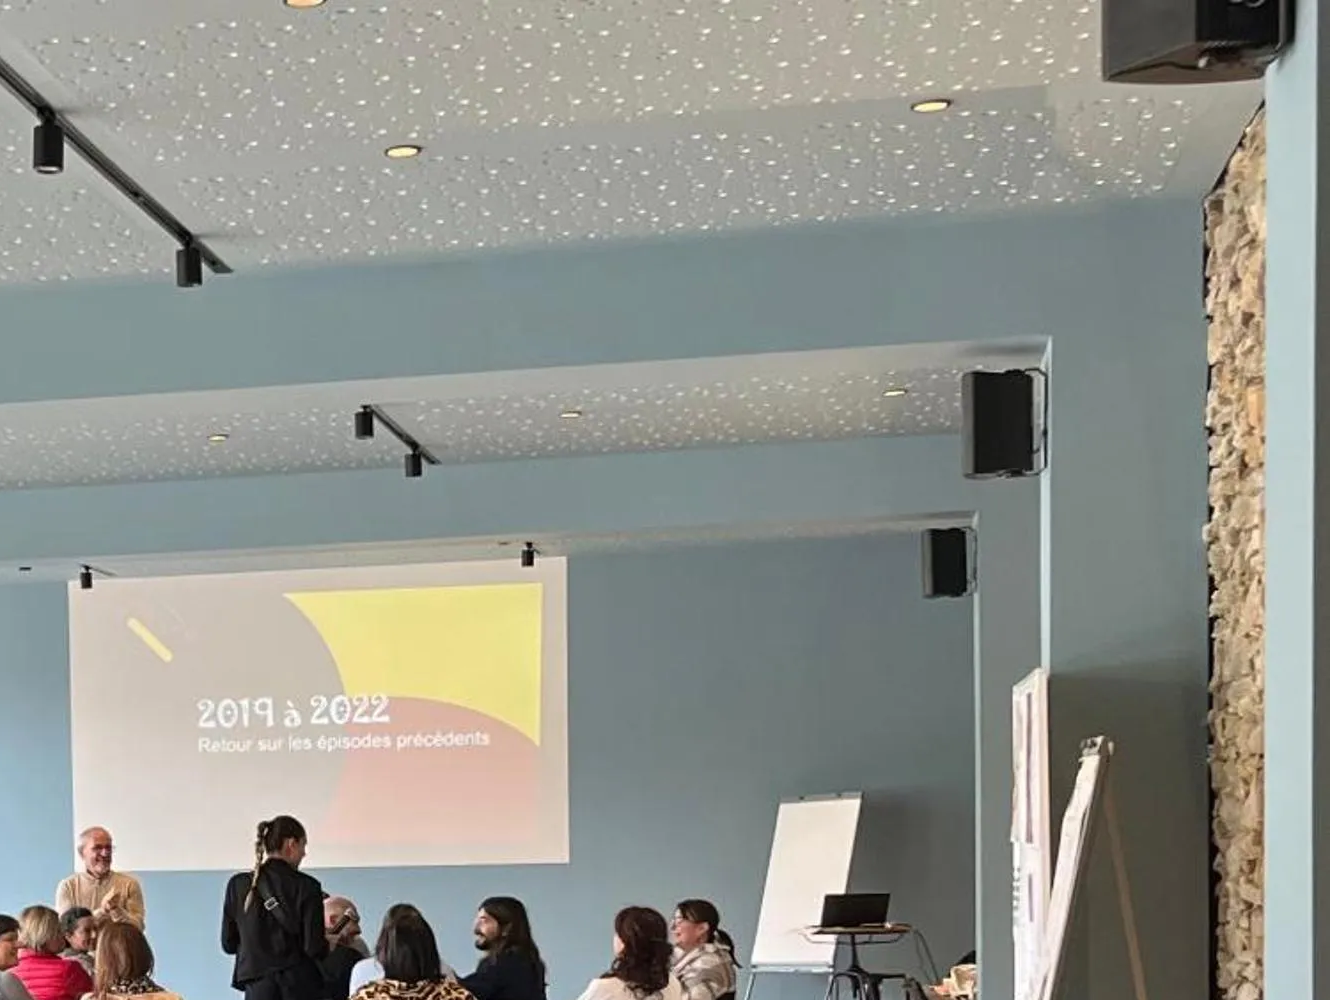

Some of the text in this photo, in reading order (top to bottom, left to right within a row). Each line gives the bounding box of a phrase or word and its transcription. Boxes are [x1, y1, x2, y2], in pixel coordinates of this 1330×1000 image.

[196, 692, 390, 728] 2019 à 2022
[198, 729, 490, 753] Retour sur les épisodes précédents
